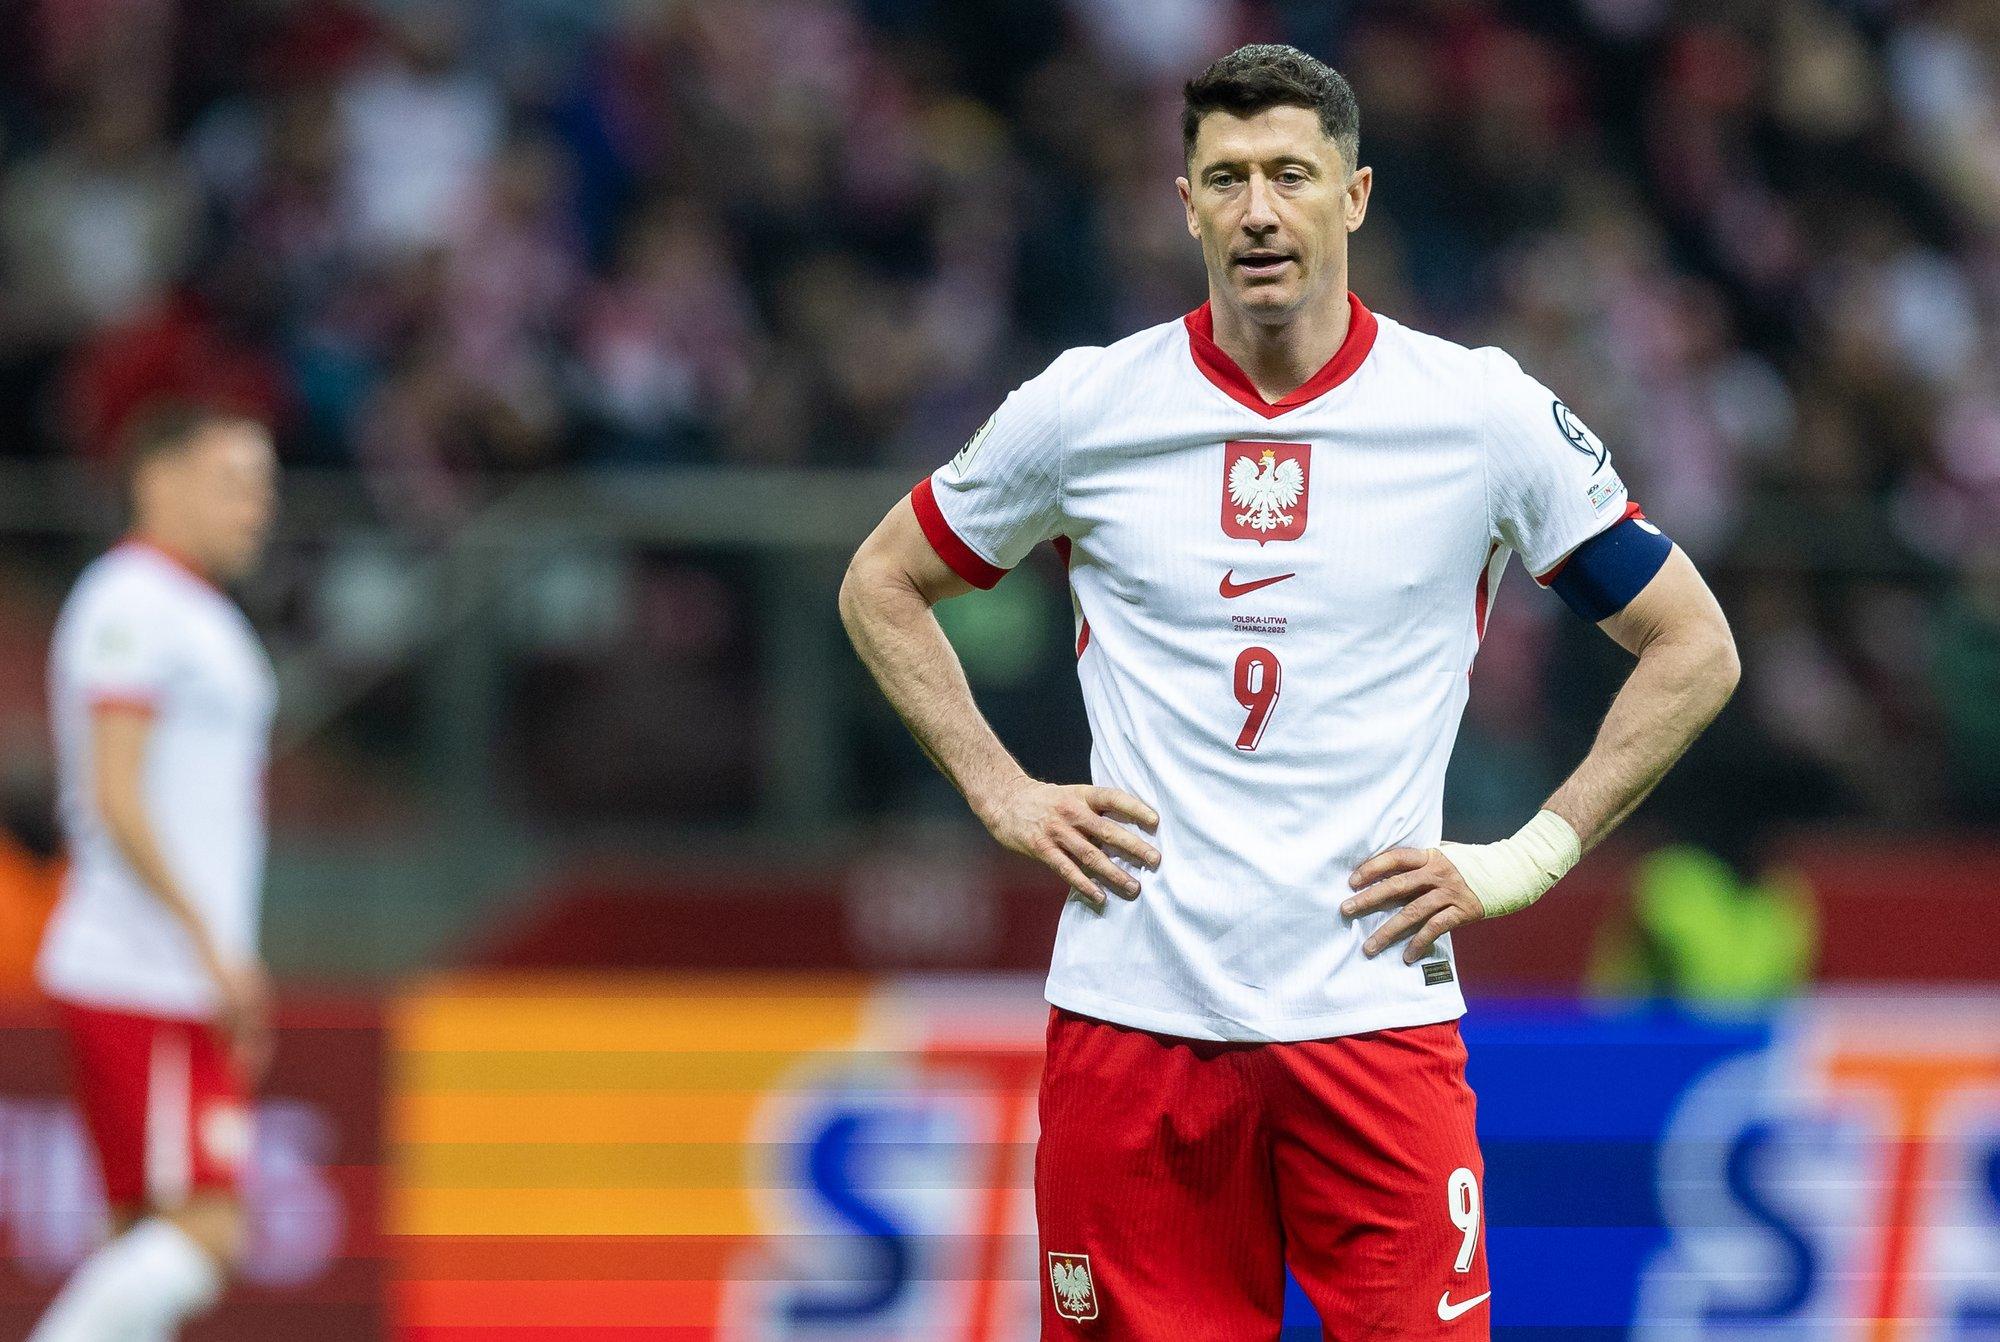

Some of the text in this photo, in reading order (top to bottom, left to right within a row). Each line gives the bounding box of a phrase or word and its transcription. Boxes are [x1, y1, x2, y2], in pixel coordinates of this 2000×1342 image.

[1231, 615, 1288, 625] POLSKA-LITWA
[1242, 625, 1267, 633] MARCA
[1267, 626, 1286, 634] 2025
[1233, 646, 1282, 751] 9
[1447, 1167, 1480, 1273] 9
[1698, 1048, 2000, 1342] ST
